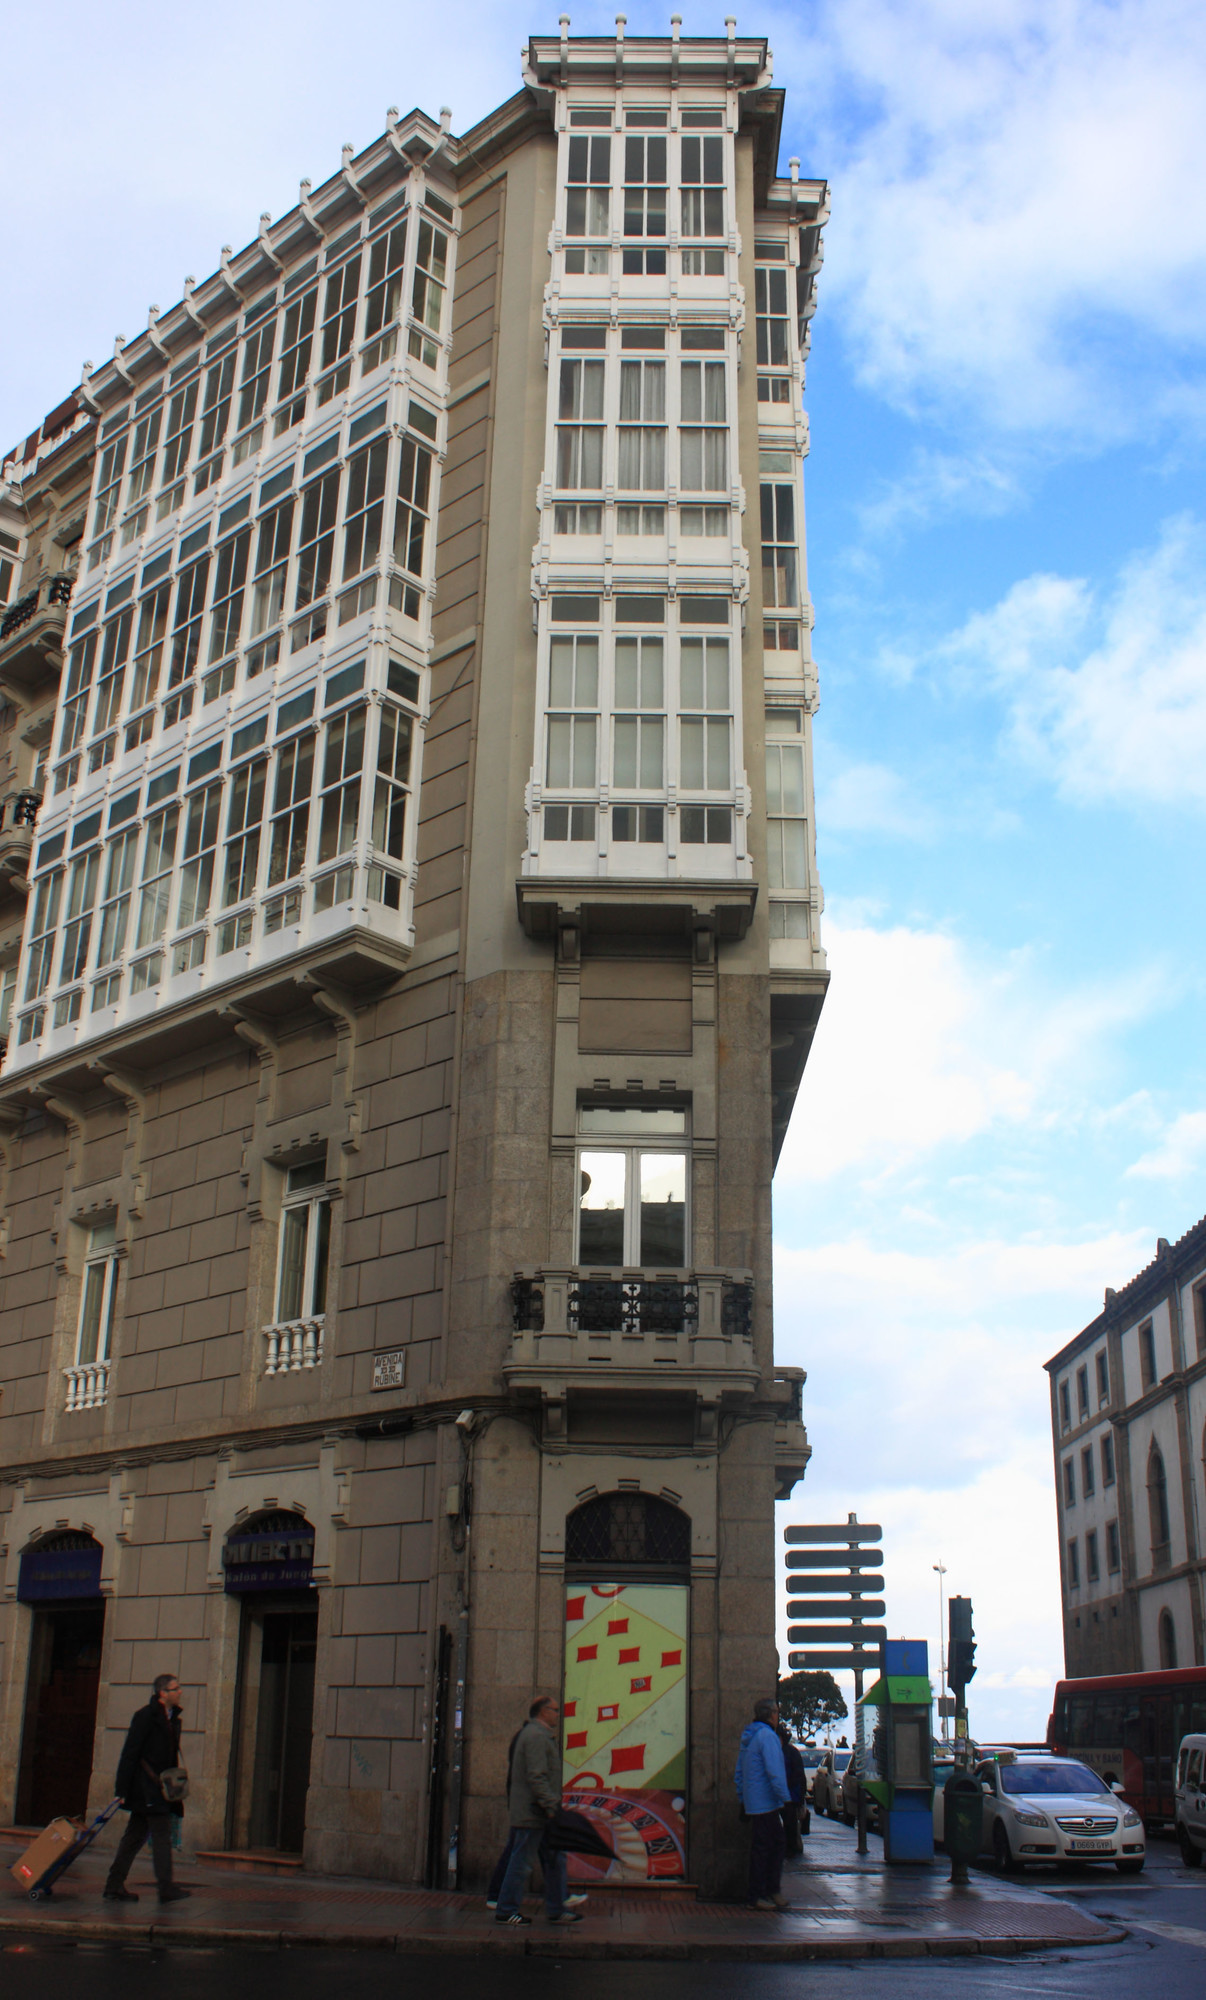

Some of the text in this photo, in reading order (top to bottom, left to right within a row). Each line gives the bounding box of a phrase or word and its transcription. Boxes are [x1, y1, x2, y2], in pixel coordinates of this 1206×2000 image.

[375, 1353, 401, 1367] AVENIDA
[375, 1372, 400, 1386] RUBINE
[648, 1836, 675, 1854] 28
[1097, 1841, 1109, 1849] GYP
[651, 1855, 680, 1874] 12
